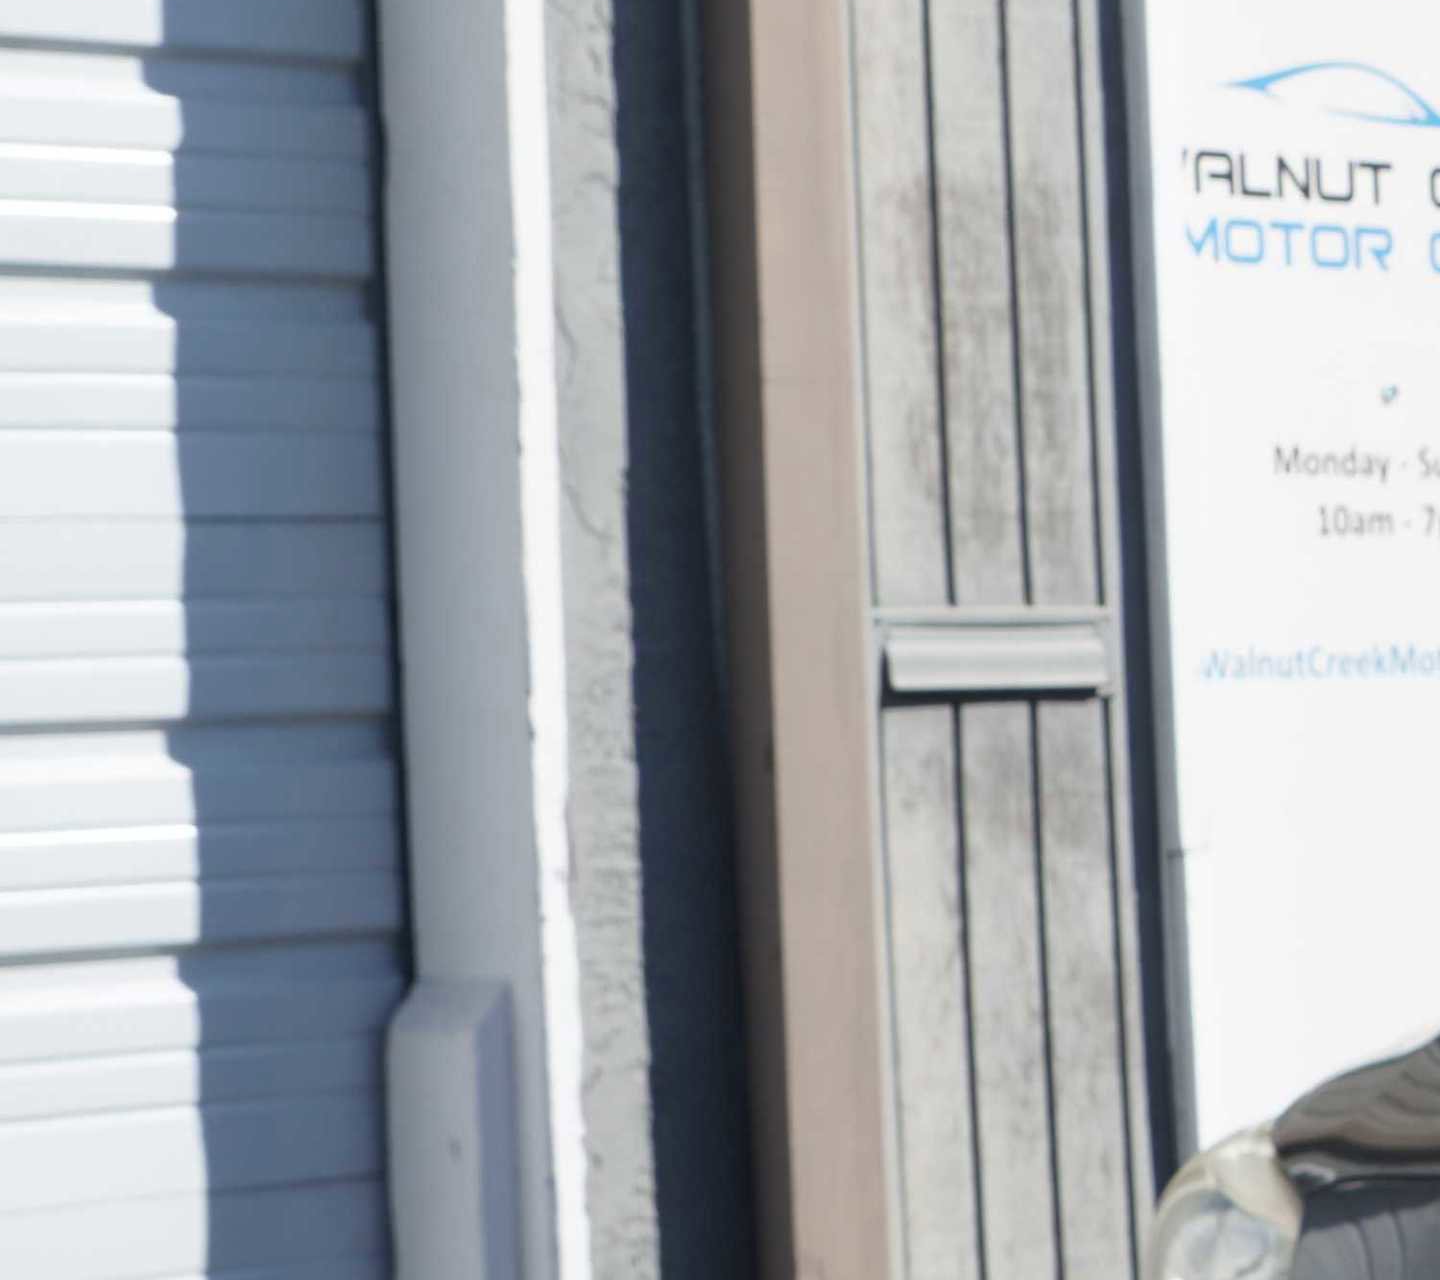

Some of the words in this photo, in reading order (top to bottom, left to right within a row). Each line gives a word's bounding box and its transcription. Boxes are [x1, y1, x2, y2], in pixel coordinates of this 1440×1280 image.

[1182, 148, 1392, 205] ALNUT
[1186, 217, 1392, 271] MOTOR
[1273, 445, 1390, 483] Monday
[1318, 505, 1394, 537] 10am
